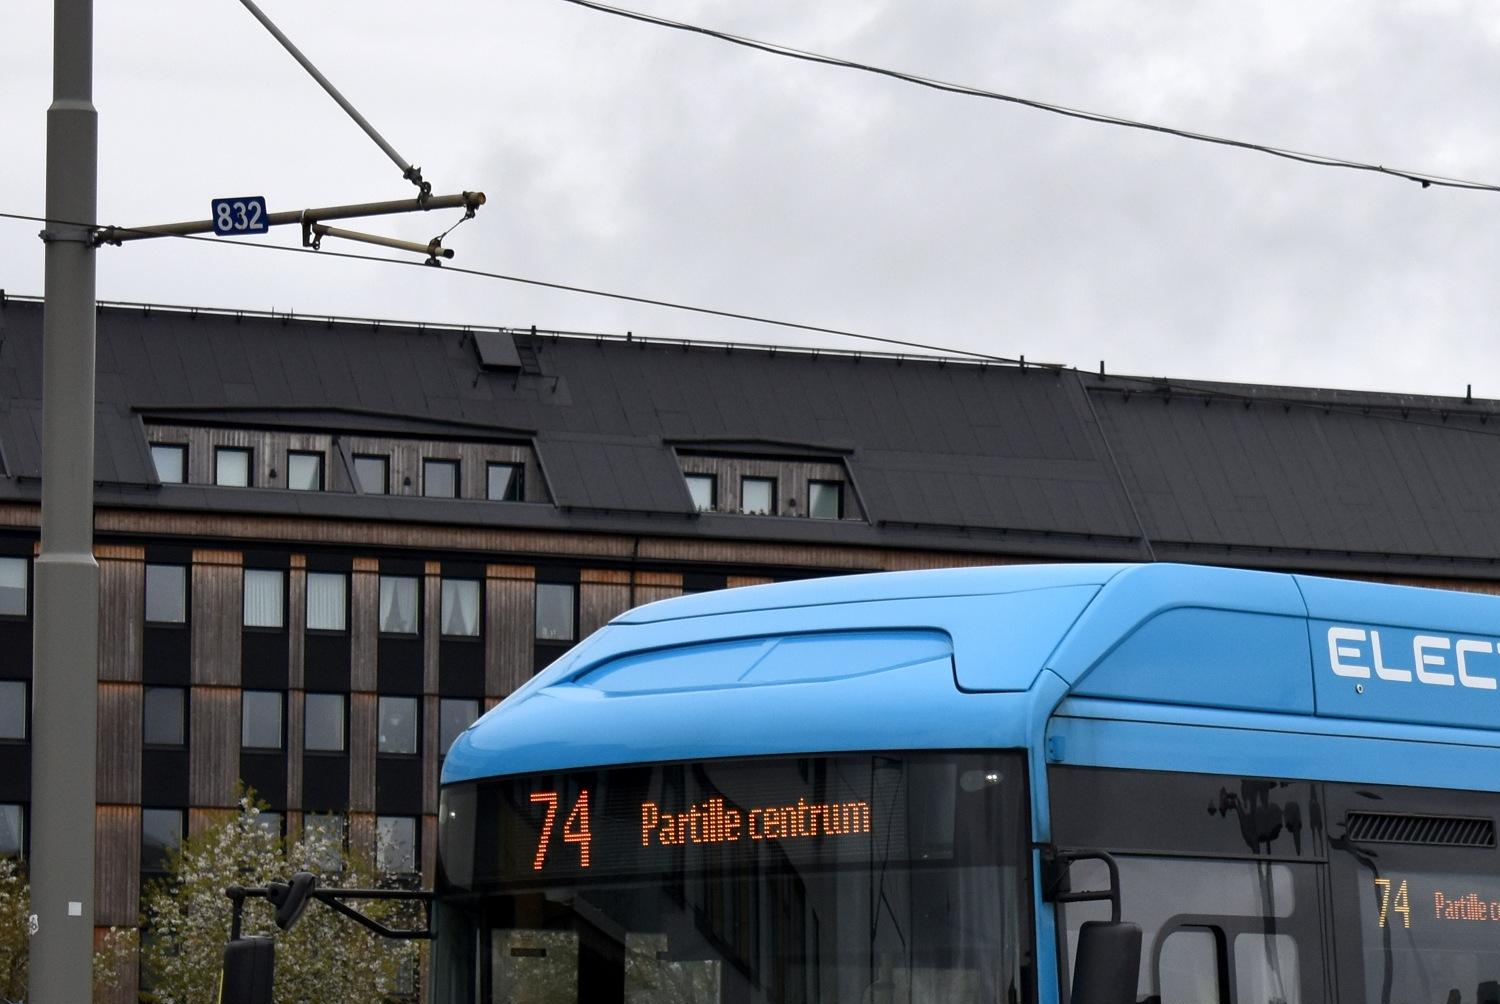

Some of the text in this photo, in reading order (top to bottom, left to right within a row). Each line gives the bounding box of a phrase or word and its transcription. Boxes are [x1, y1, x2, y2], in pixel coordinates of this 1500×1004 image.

[217, 201, 263, 231] 832
[530, 790, 871, 870] 74 Partille centrum
[1375, 879, 1410, 928] 74
[1434, 892, 1487, 920] Partille
